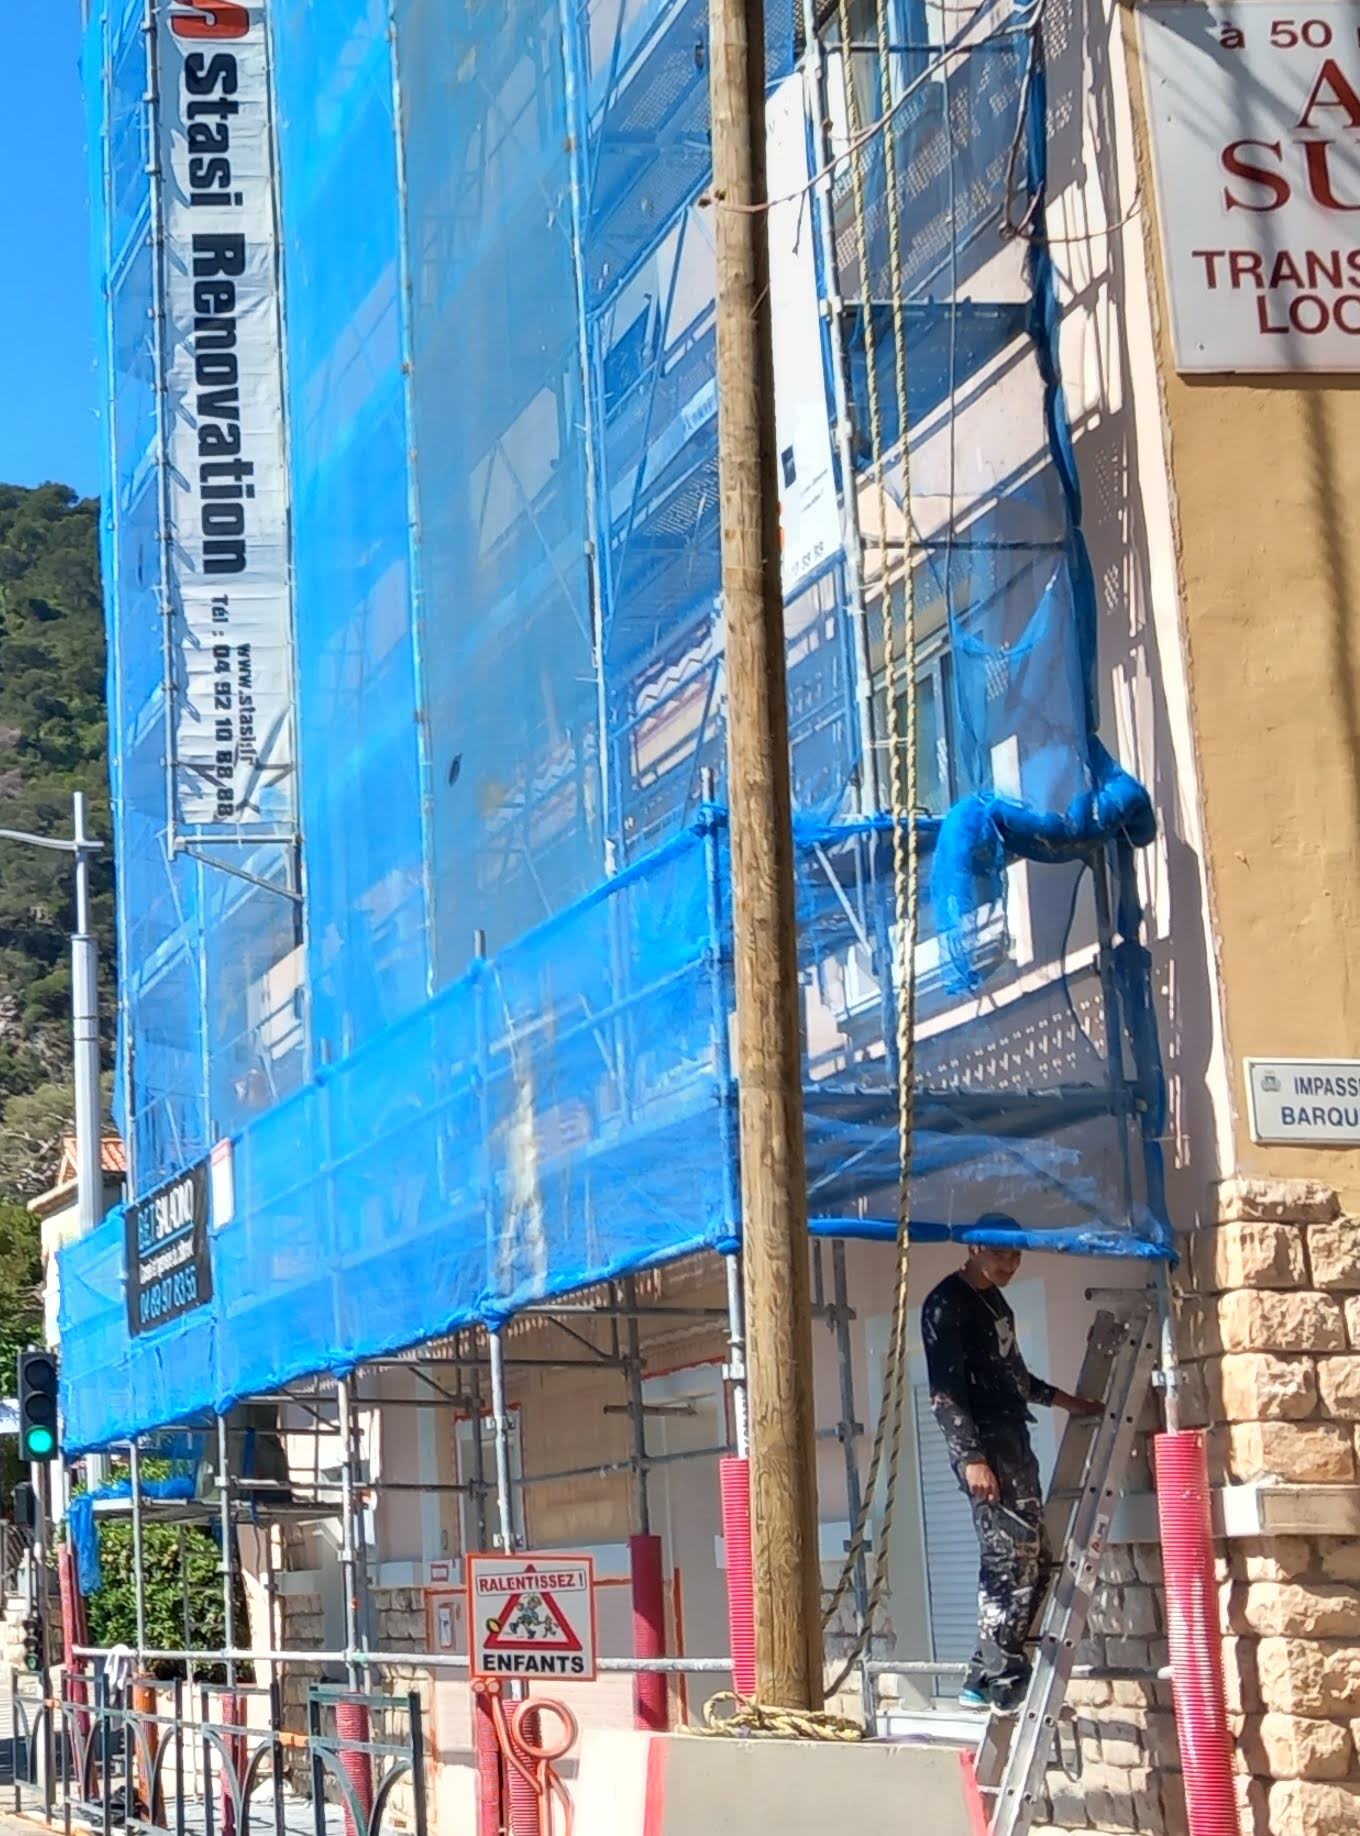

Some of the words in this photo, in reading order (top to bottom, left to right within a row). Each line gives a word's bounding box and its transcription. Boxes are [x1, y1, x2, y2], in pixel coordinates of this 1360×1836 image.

[1220, 18, 1246, 49] à
[1269, 19, 1333, 49] 50
[184, 52, 243, 207] Stasi
[191, 232, 256, 575] Renovation
[213, 644, 231, 674] 04
[214, 681, 233, 710] 92
[215, 717, 234, 742] 10
[1294, 1076, 1360, 1097] IMPASS
[479, 1573, 575, 1593] RALENTISSEZ
[483, 1654, 585, 1674] ENFANTS
